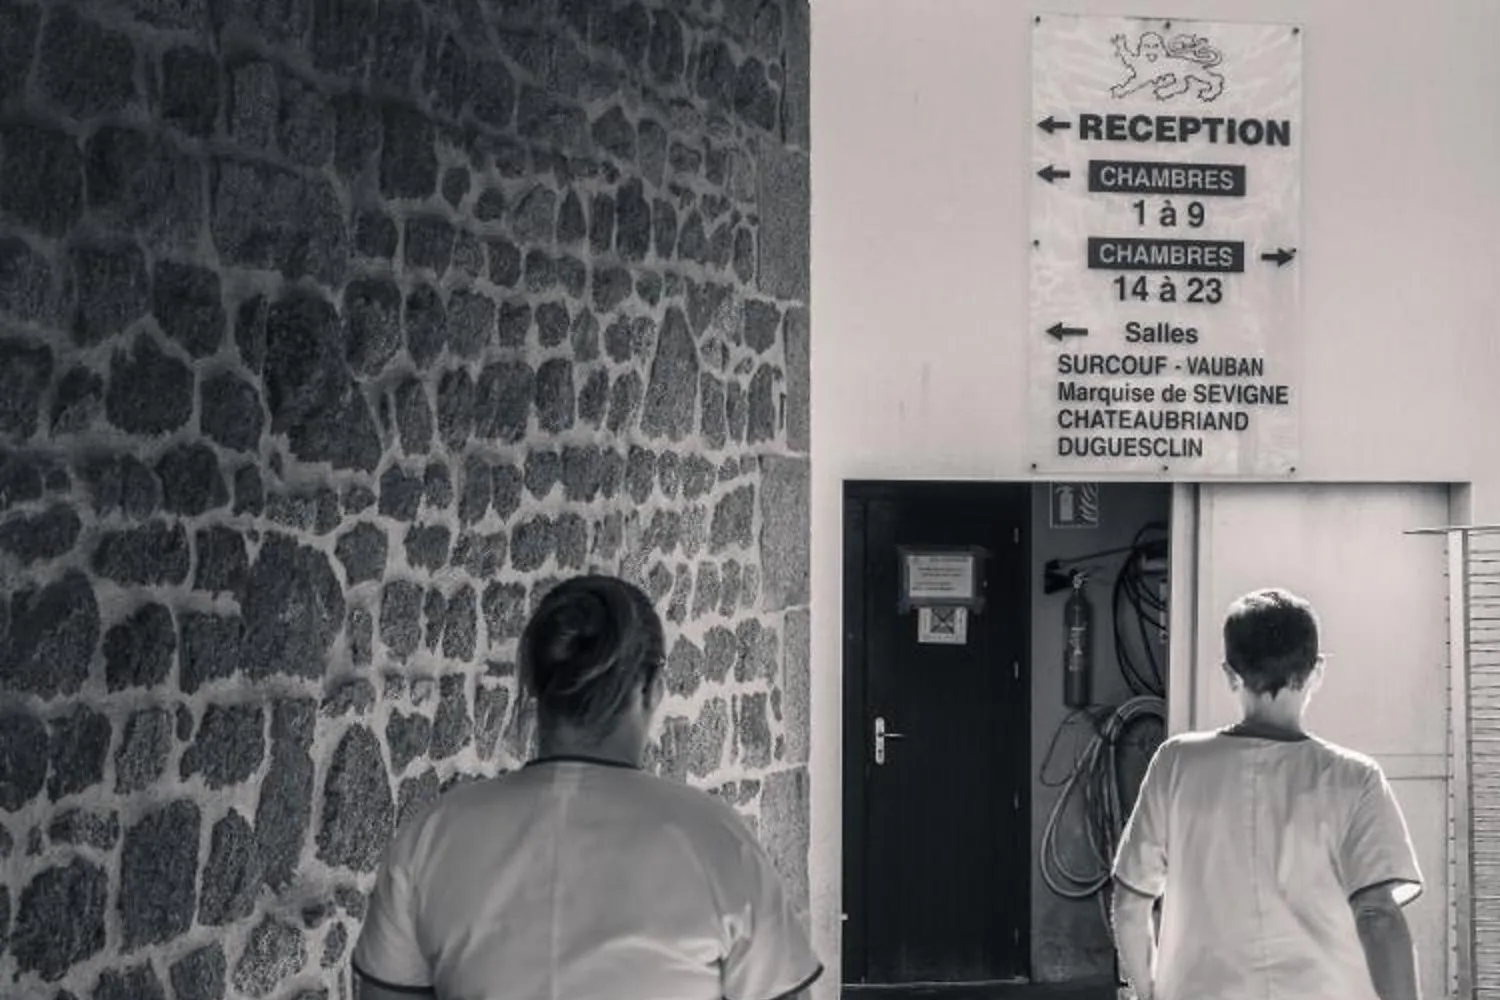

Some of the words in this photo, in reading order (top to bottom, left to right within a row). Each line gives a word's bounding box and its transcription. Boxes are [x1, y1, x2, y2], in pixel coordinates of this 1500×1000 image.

[1079, 113, 1291, 147] RECEPTION
[1099, 166, 1235, 190] CHAMBRES
[1132, 200, 1146, 225] 1
[1159, 200, 1177, 228] à
[1187, 201, 1205, 228] 9
[1099, 243, 1234, 267] CHAMBRES
[1113, 276, 1149, 301] 14
[1159, 276, 1177, 303] à
[1187, 278, 1223, 304] 23
[1125, 322, 1199, 343] Salles
[1057, 355, 1168, 376] SURCOUF
[1187, 358, 1264, 377] VAUBAN
[1057, 382, 1155, 406] Marquise
[1161, 384, 1187, 403] de
[1193, 384, 1289, 406] SEVIGNE
[1057, 410, 1250, 431] CHATEAUBRIAND
[1057, 438, 1204, 458] DUGUESCLIN
